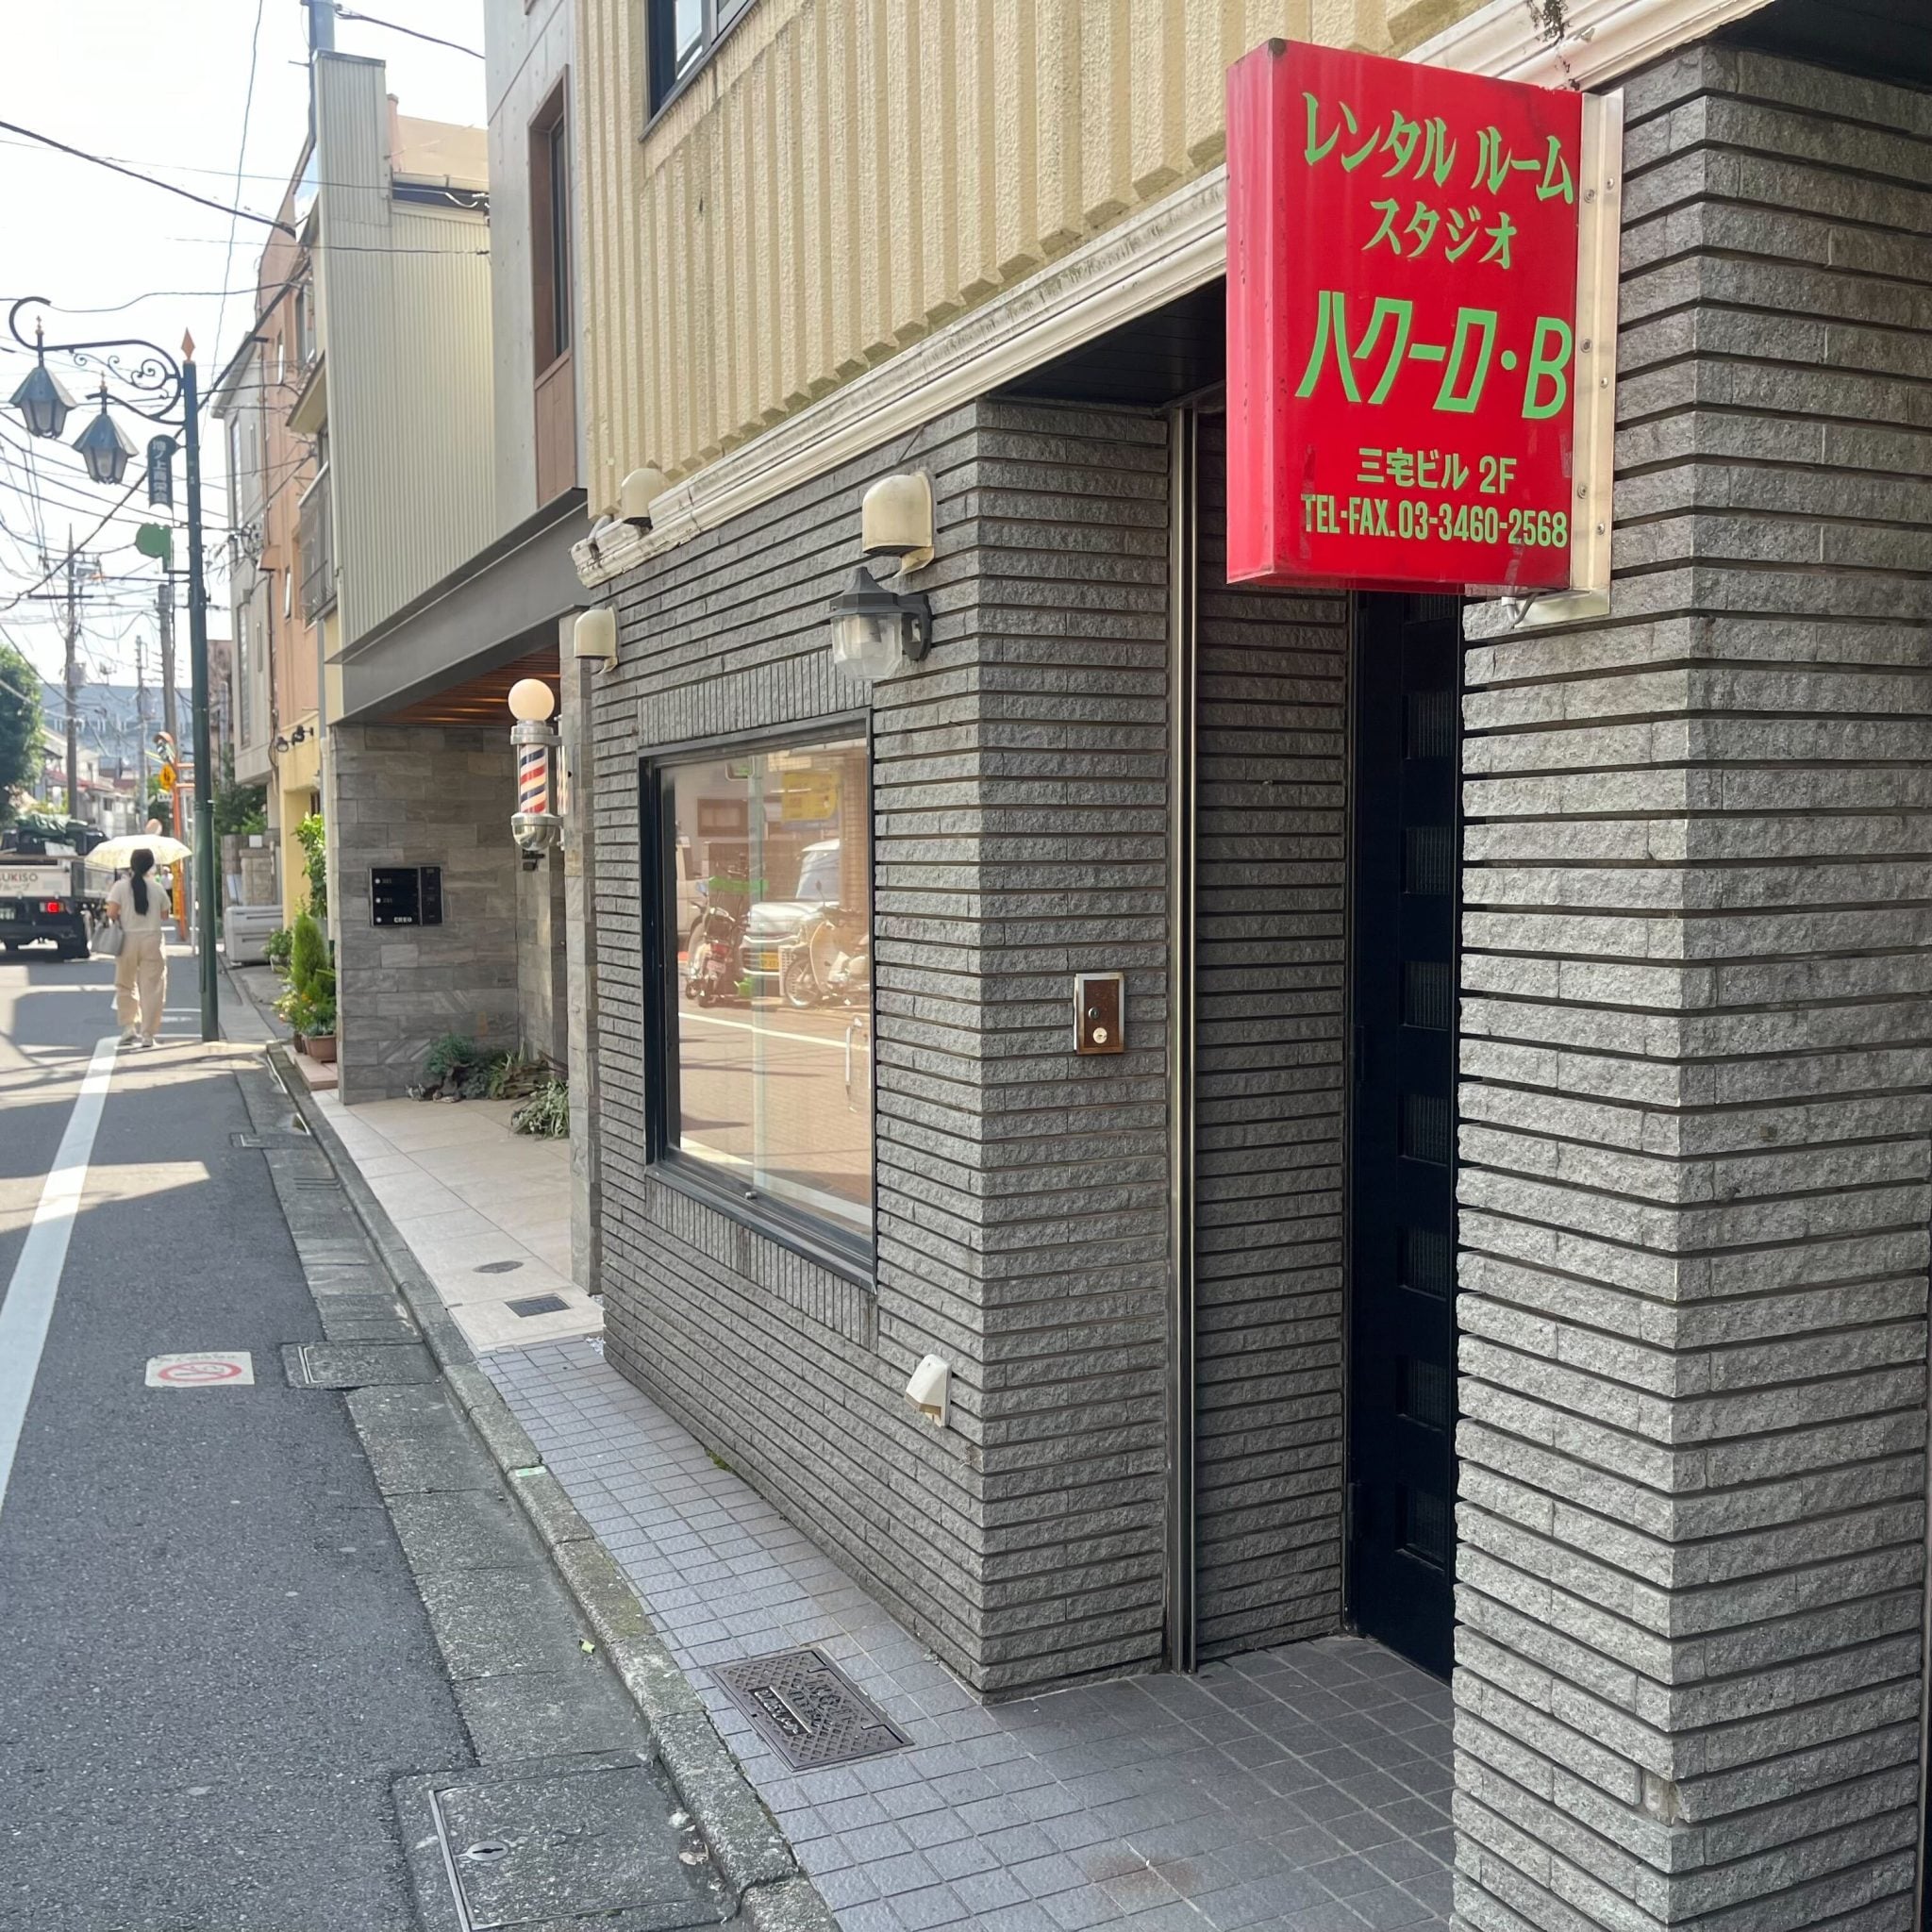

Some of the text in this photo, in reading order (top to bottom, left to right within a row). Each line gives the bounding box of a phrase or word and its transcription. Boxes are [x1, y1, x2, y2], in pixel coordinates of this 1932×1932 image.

[1302, 92, 1574, 205] レンタル ルーム
[1361, 197, 1517, 270] スタジオ
[1357, 447, 1517, 494] 三宅ビル 2F
